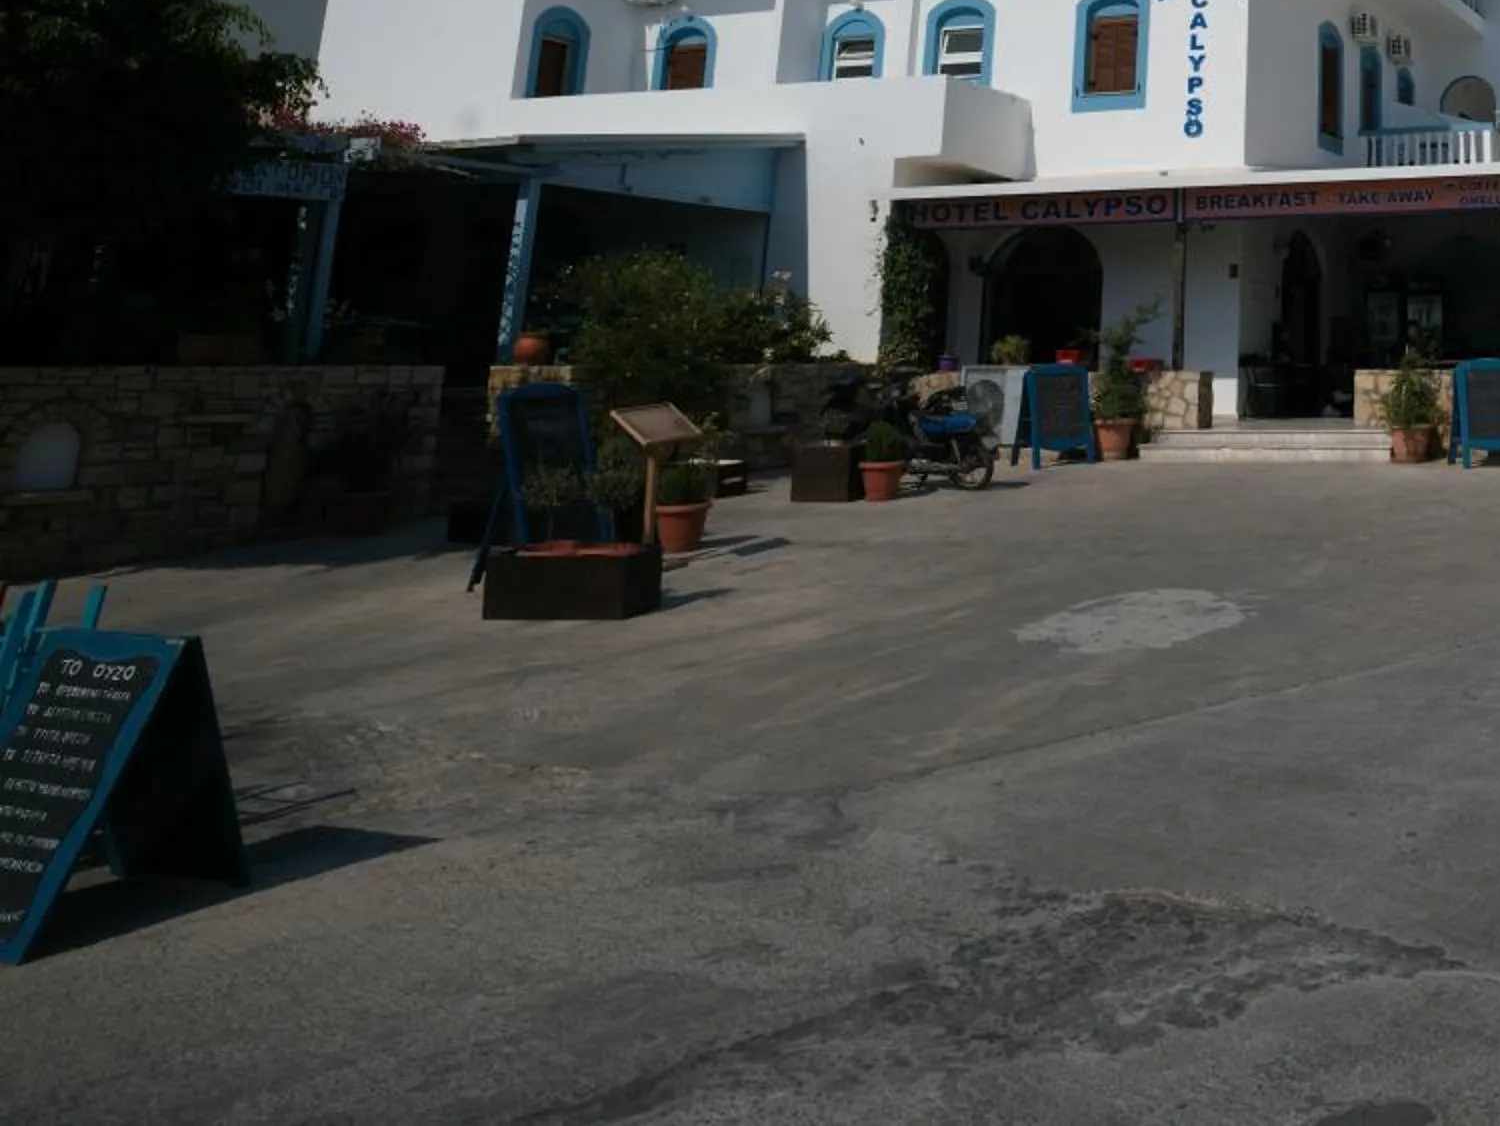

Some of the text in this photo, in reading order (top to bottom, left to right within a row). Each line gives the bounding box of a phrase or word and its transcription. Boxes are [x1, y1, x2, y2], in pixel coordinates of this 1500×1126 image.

[910, 194, 1169, 223] HOTEL CALYPSO
[1195, 190, 1319, 211] BREAKFAST
[1387, 188, 1435, 204] AWAY
